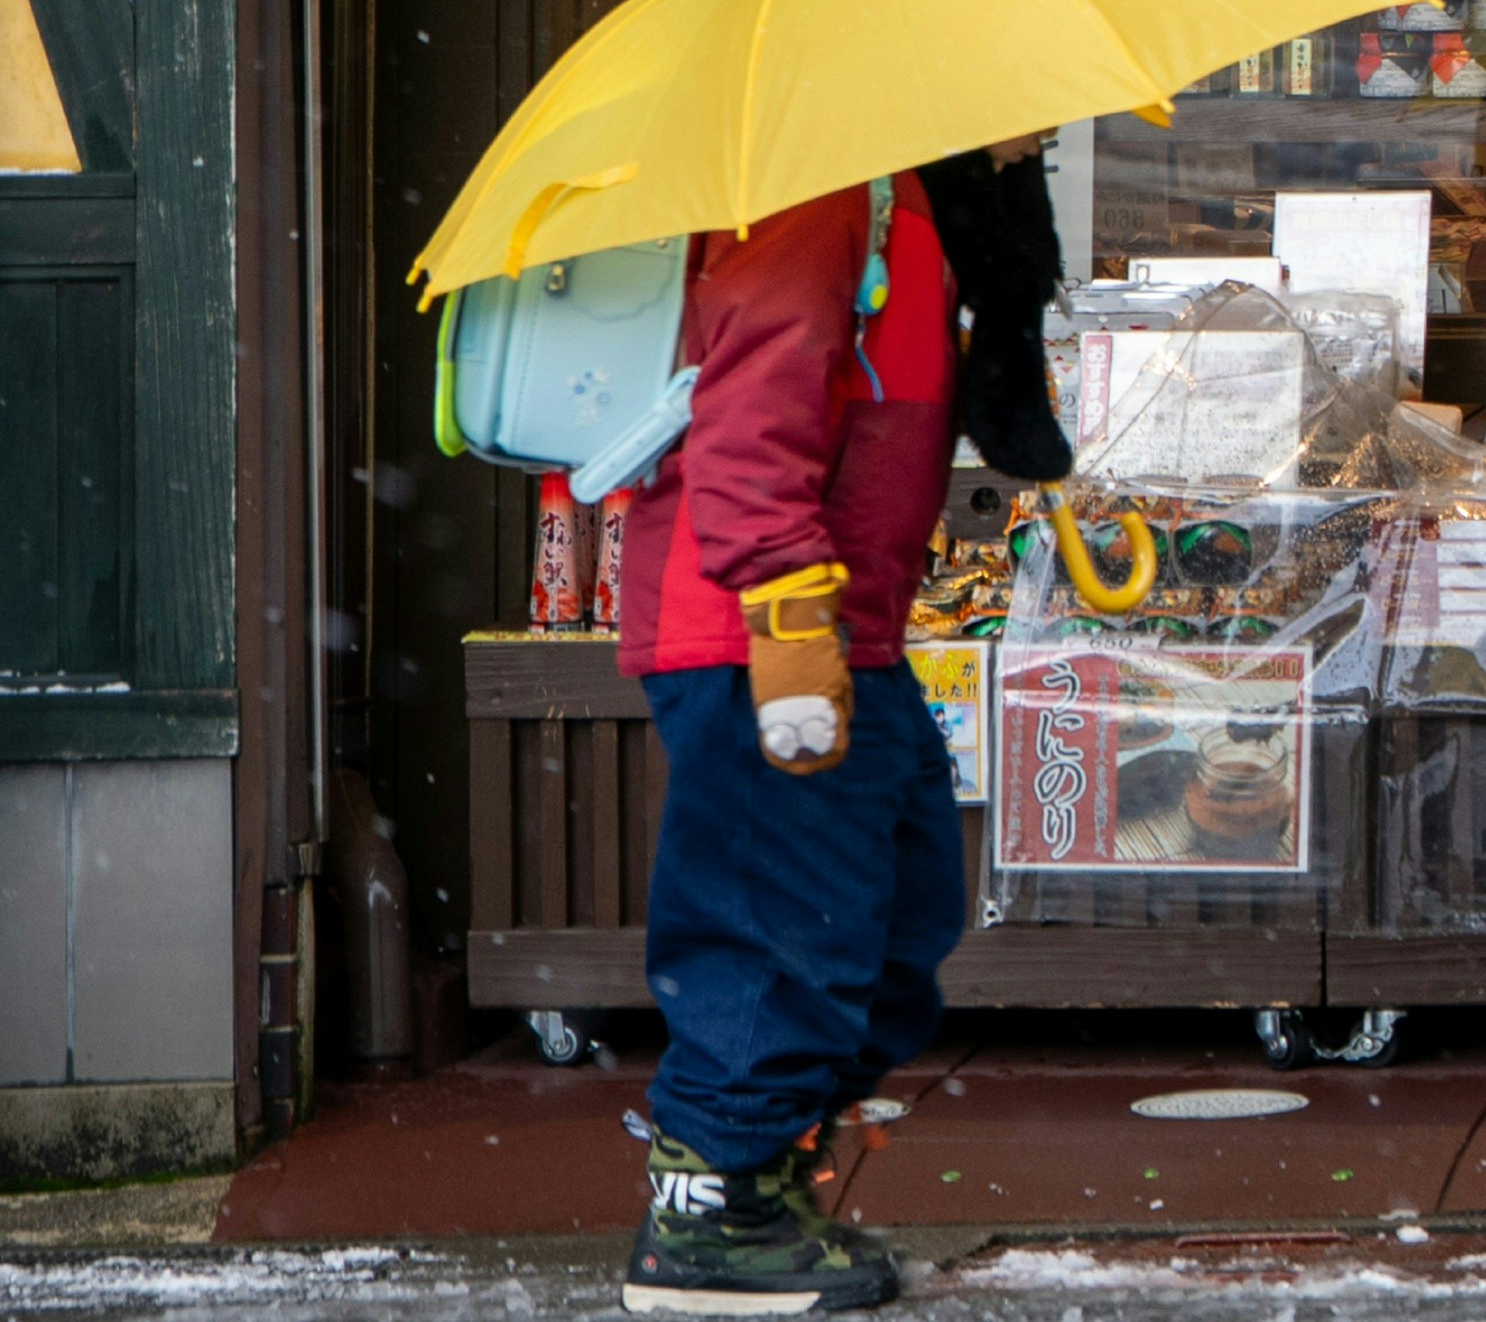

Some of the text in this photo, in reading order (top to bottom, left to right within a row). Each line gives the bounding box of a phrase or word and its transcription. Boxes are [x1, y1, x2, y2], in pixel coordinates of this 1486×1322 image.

[1032, 658, 1087, 861] うにのり
[649, 1171, 726, 1216] VIS
